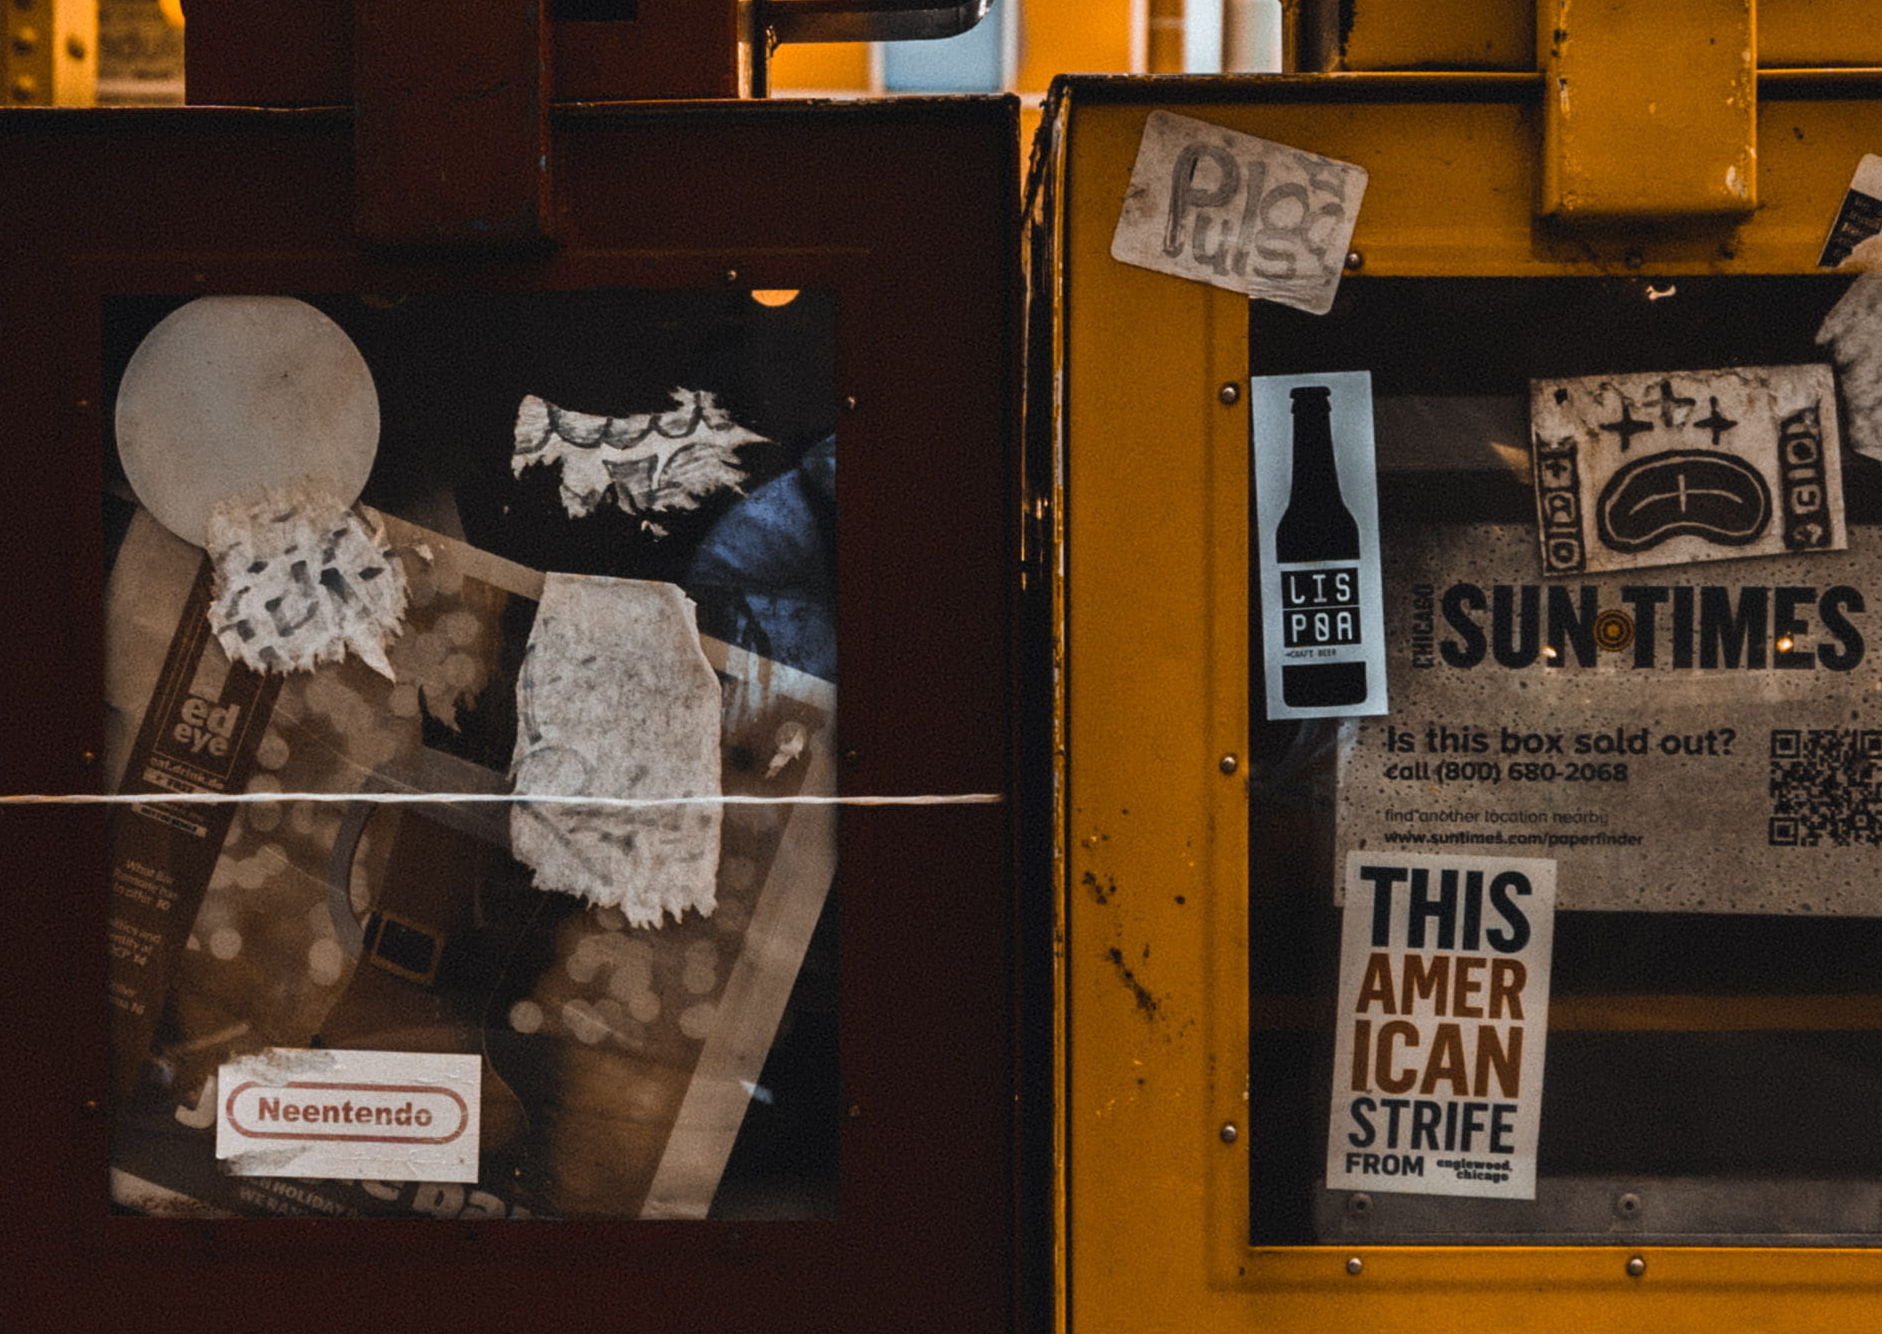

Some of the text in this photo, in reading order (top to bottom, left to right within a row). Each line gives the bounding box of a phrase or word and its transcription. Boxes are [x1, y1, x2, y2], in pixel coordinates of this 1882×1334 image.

[1290, 573, 1351, 605] LIS
[1416, 584, 1434, 669] CHICAGO
[1386, 725, 1738, 756] Is this box sold out?
[1384, 761, 1629, 785] call (800) 680-2068
[1384, 808, 1611, 829] find another location nearby
[1383, 829, 1645, 849] www.suntimes.com/paperfinder
[1359, 865, 1532, 954] THIS
[1355, 951, 1528, 1021] AMER
[1350, 1018, 1525, 1099] ICAN
[257, 1096, 433, 1128] Neentendo
[1348, 1097, 1518, 1154] STRIFE
[1345, 1152, 1425, 1178] FROM
[1455, 1169, 1510, 1184] chicago
